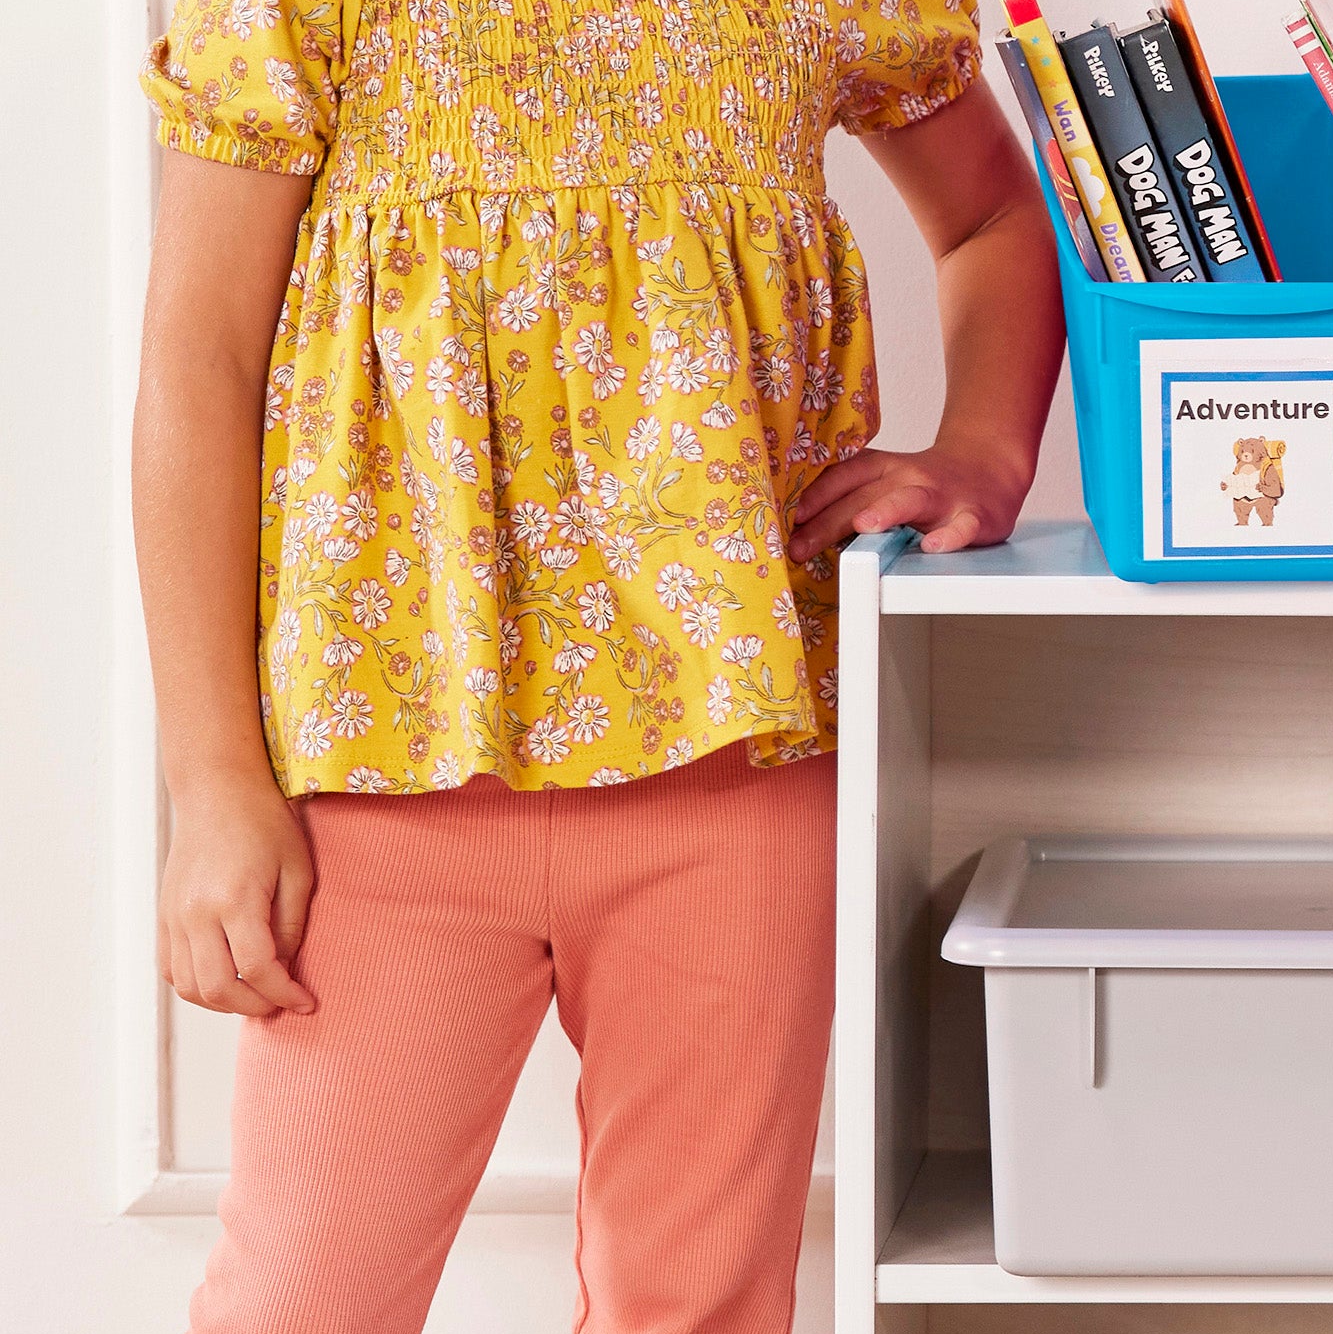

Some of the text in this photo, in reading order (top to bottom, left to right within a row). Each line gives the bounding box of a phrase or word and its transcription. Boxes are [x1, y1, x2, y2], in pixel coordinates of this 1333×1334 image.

[1053, 100, 1077, 142] Wan
[1117, 144, 1167, 211] DOG
[1175, 139, 1248, 265] DOG MAN
[1141, 211, 1191, 271] MAN
[1176, 398, 1330, 422] Adventure
